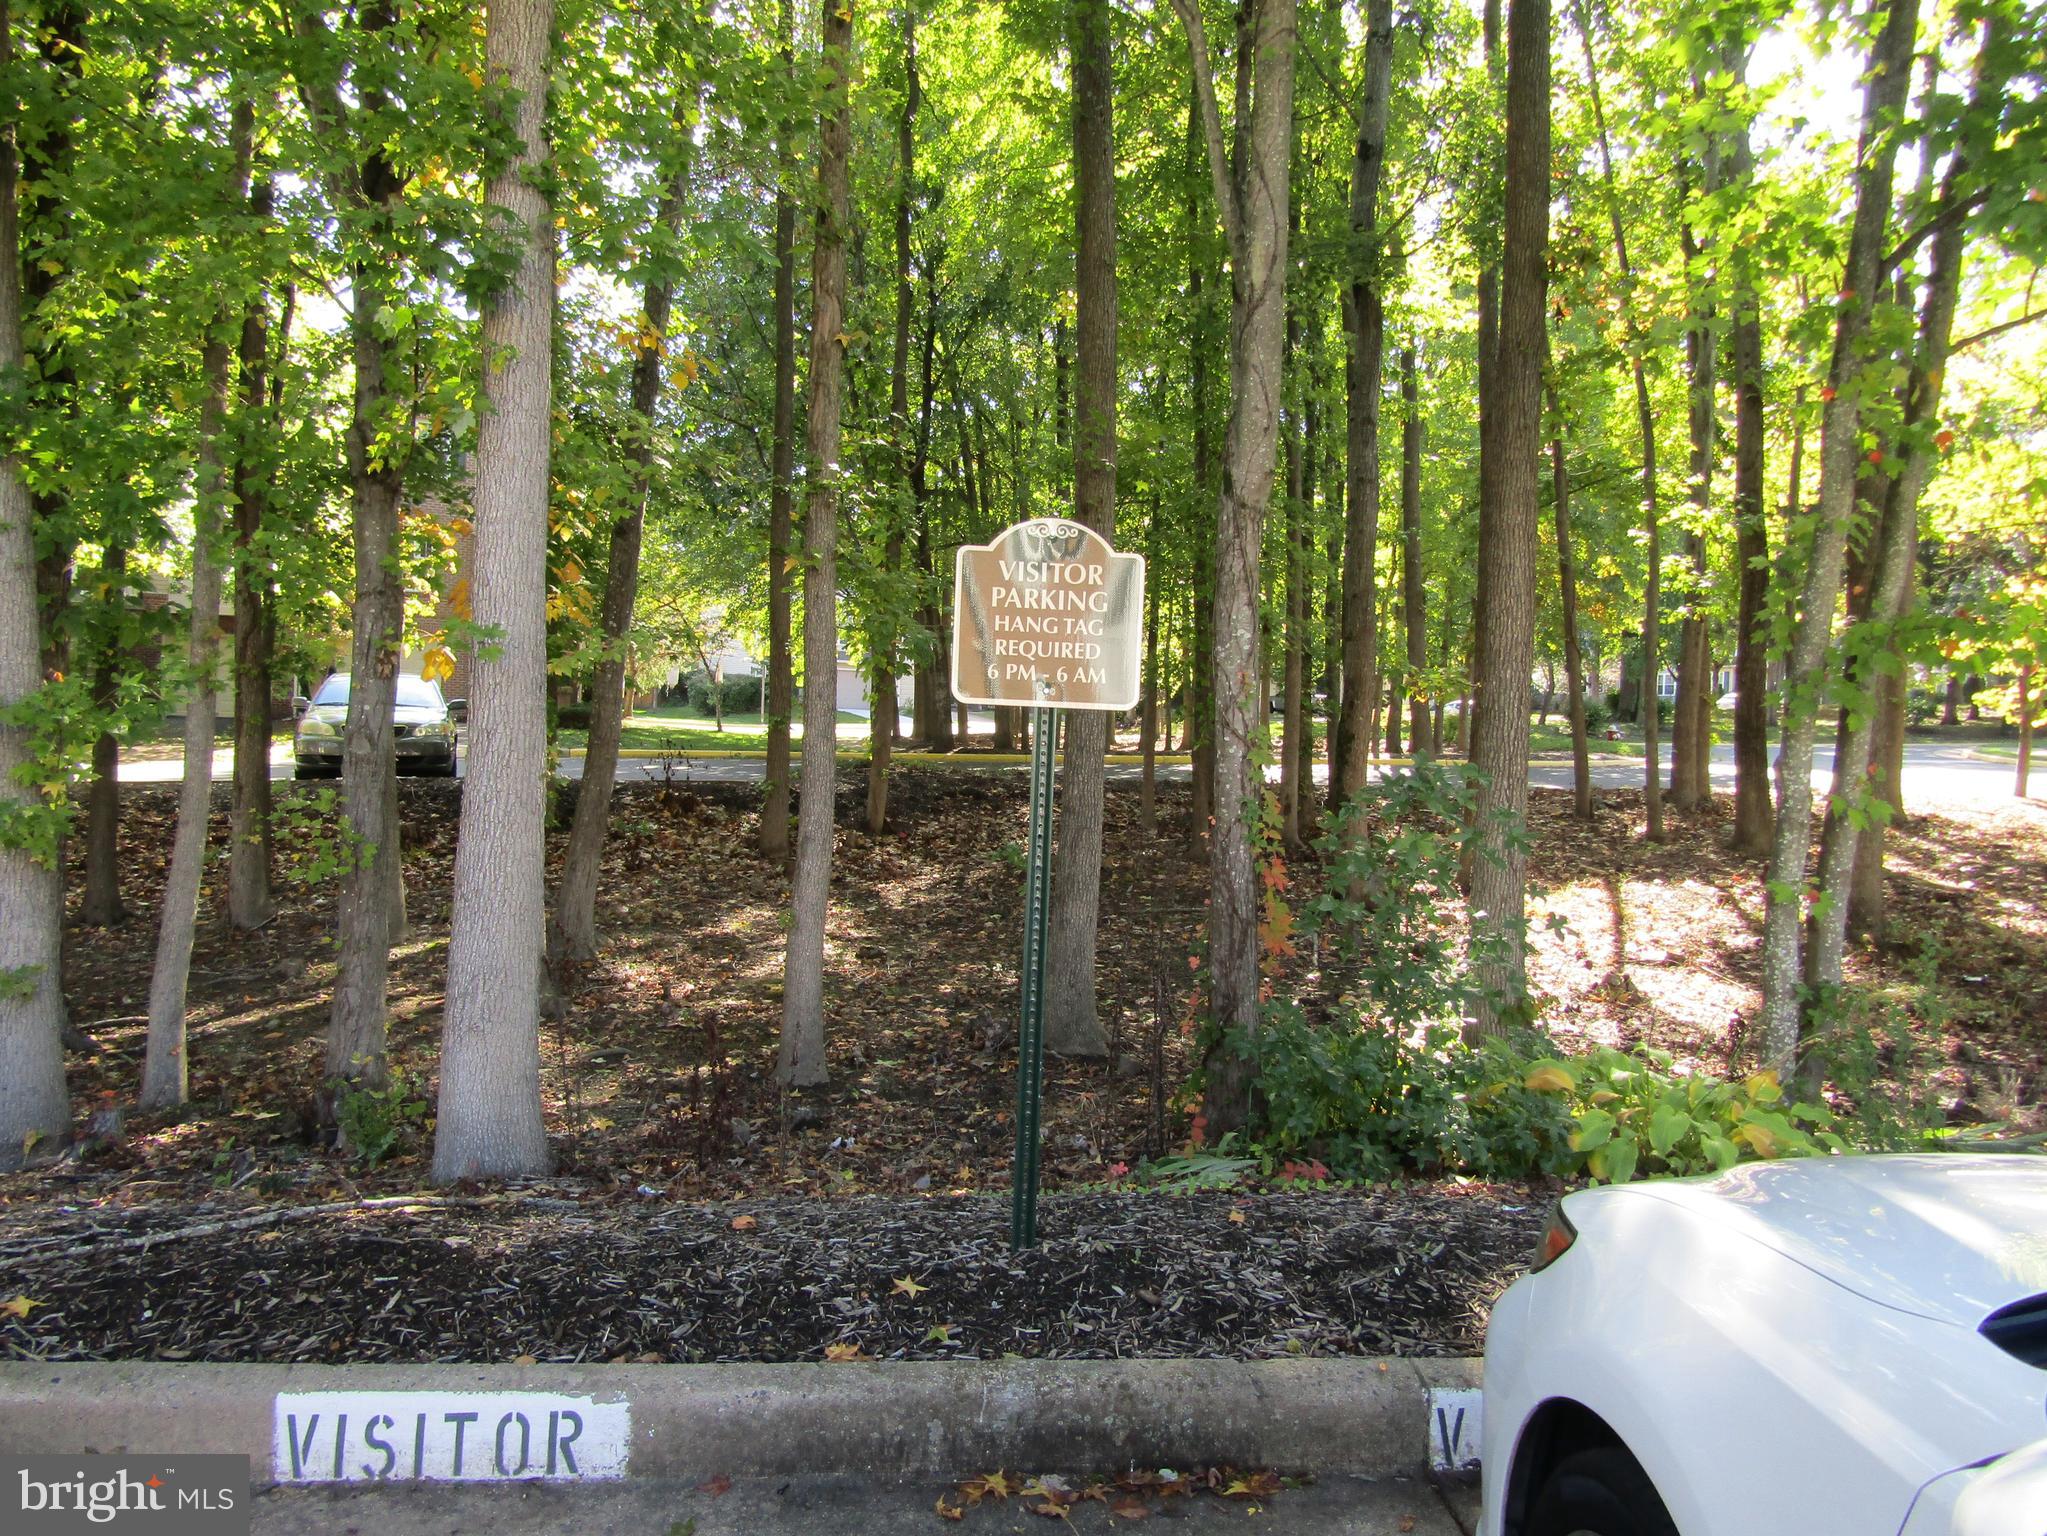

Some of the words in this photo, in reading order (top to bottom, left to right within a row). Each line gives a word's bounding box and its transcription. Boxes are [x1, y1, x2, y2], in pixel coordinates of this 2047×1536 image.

[998, 560, 1103, 586] VISITOR
[991, 586, 1108, 613] PARKING
[994, 615, 1058, 634] HANG
[1064, 618, 1104, 636] TAG
[995, 639, 1100, 661] REQUIRED
[987, 663, 999, 680] 6
[1006, 664, 1036, 681] PM
[1056, 665, 1068, 682] 6
[1073, 667, 1106, 684] AM
[286, 1409, 585, 1480] VISITOR
